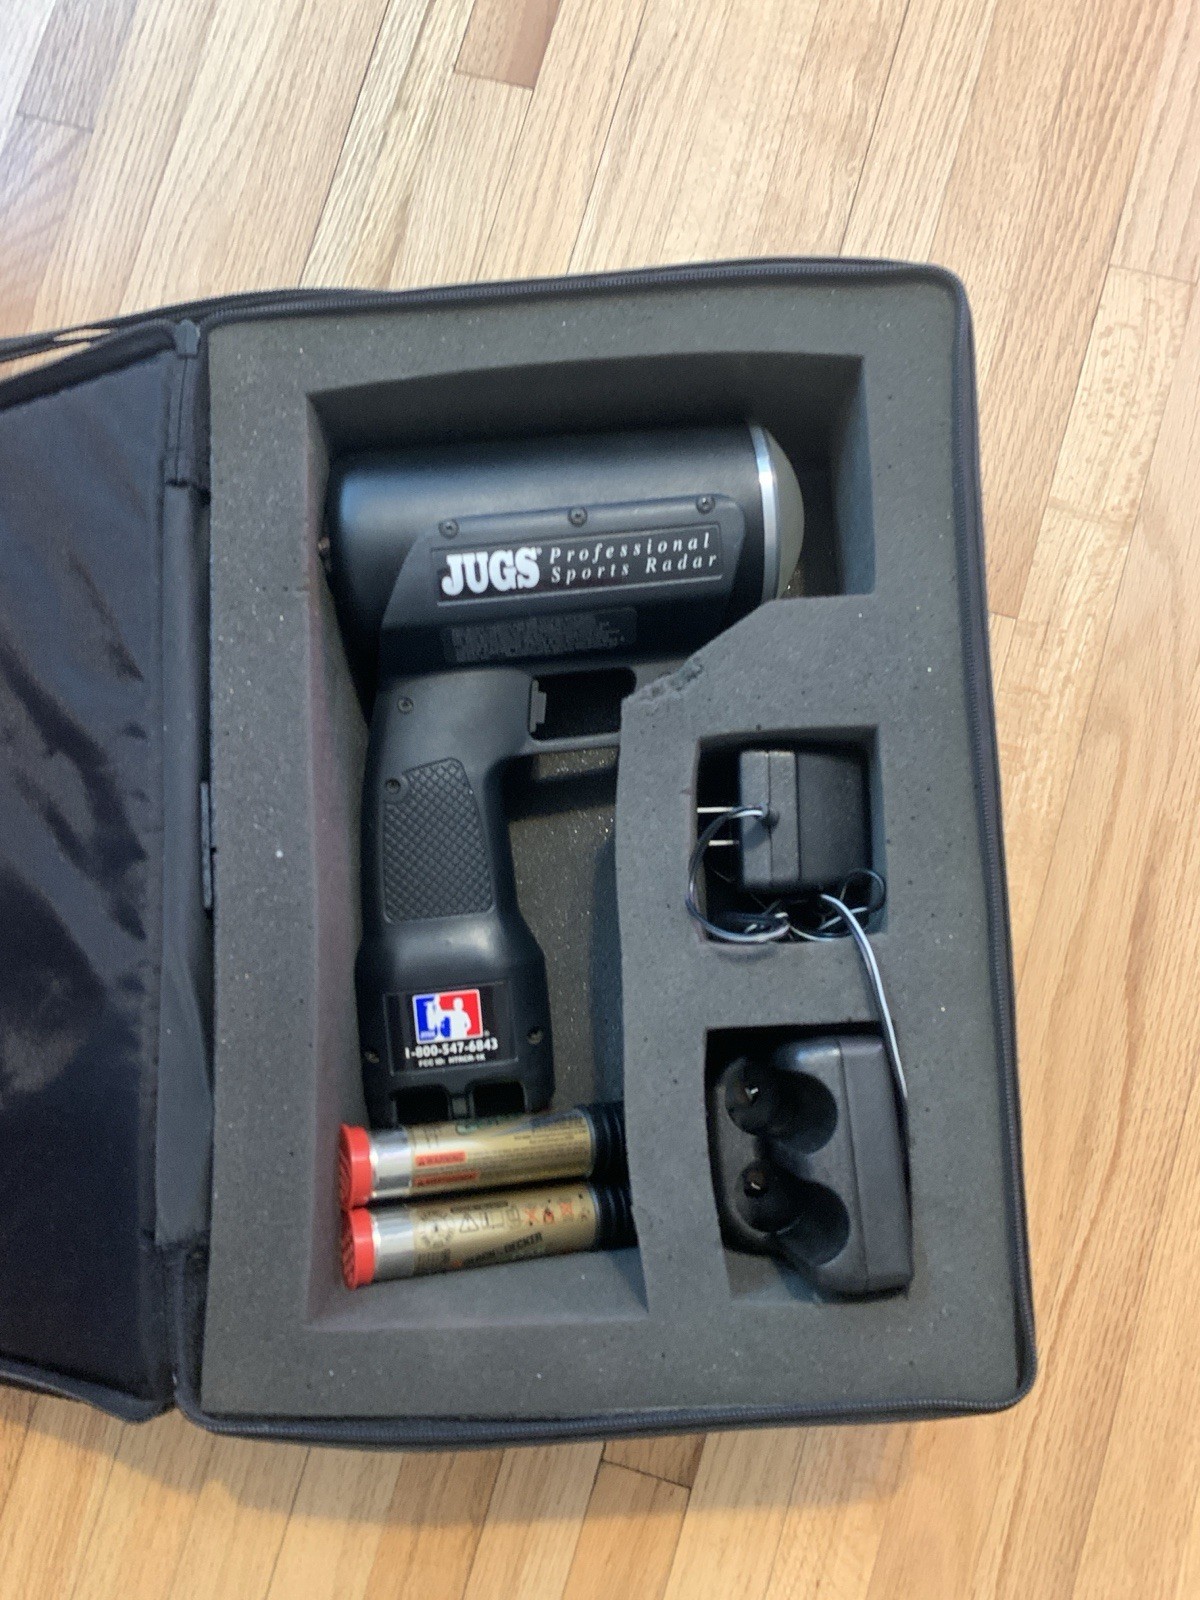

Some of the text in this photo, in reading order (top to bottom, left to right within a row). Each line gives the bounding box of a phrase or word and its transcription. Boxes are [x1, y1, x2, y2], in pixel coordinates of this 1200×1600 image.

[550, 532, 710, 564] Professional
[441, 547, 541, 596] JUGS
[551, 553, 718, 585] Sports Radar
